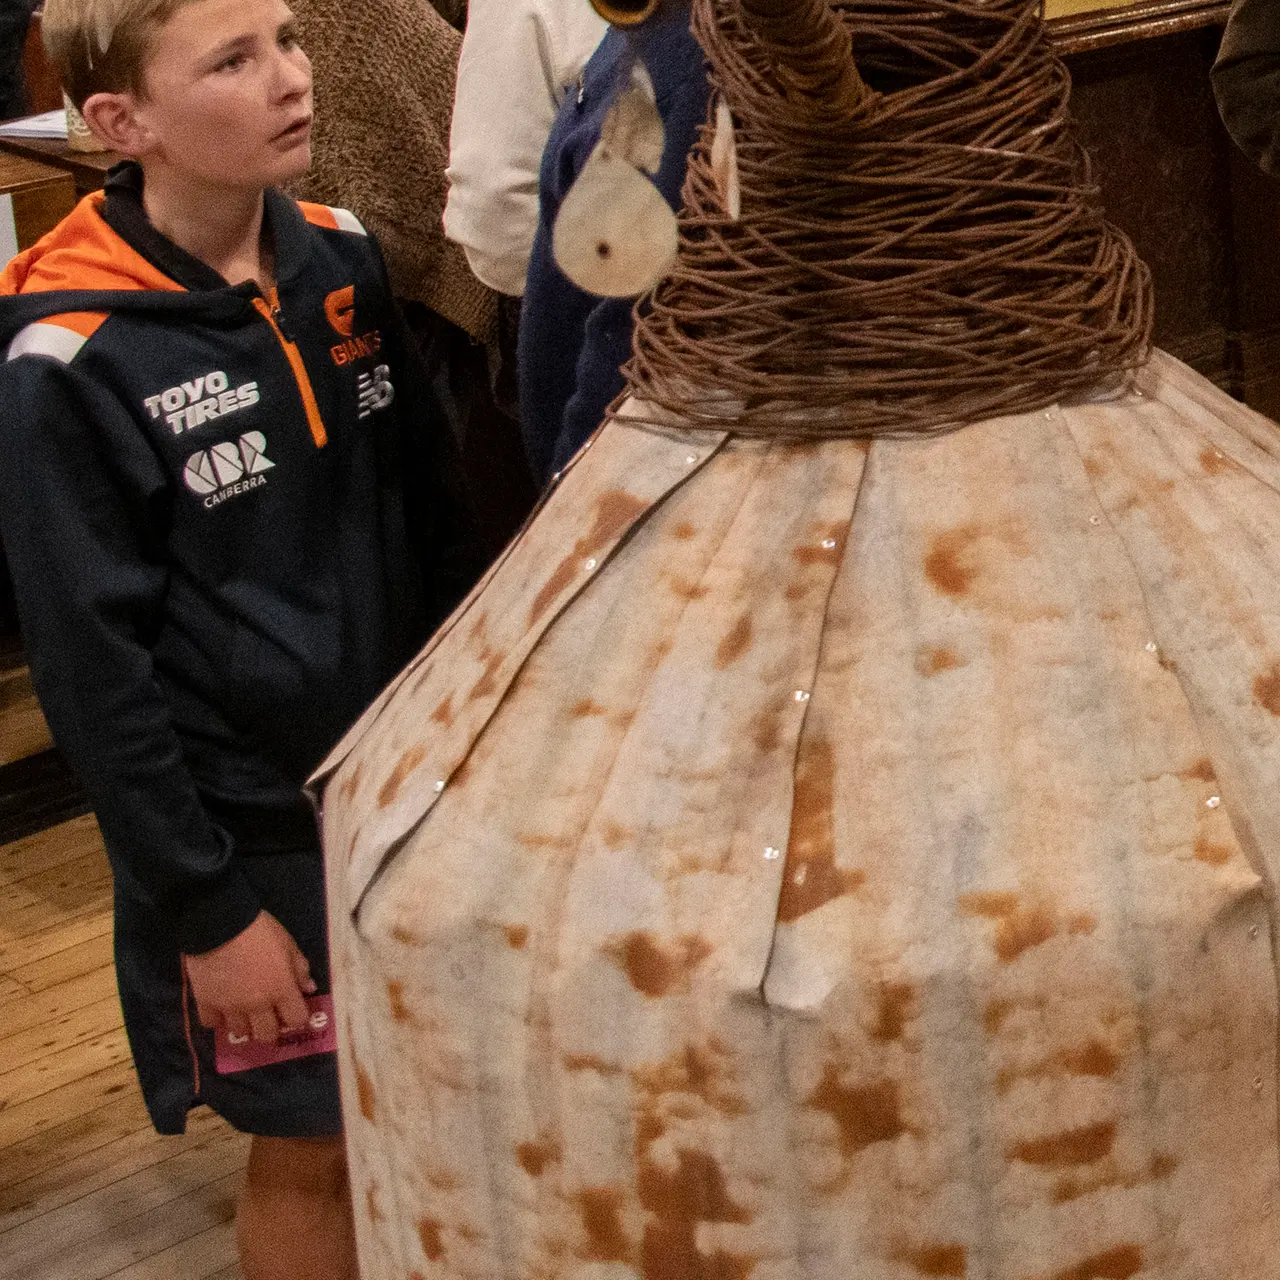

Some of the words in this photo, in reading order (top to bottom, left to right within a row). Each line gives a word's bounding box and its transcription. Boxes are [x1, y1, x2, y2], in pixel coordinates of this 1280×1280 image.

[144, 371, 229, 418] TOYO
[166, 381, 260, 434] TIRES
[203, 474, 267, 508] CANBERRA
